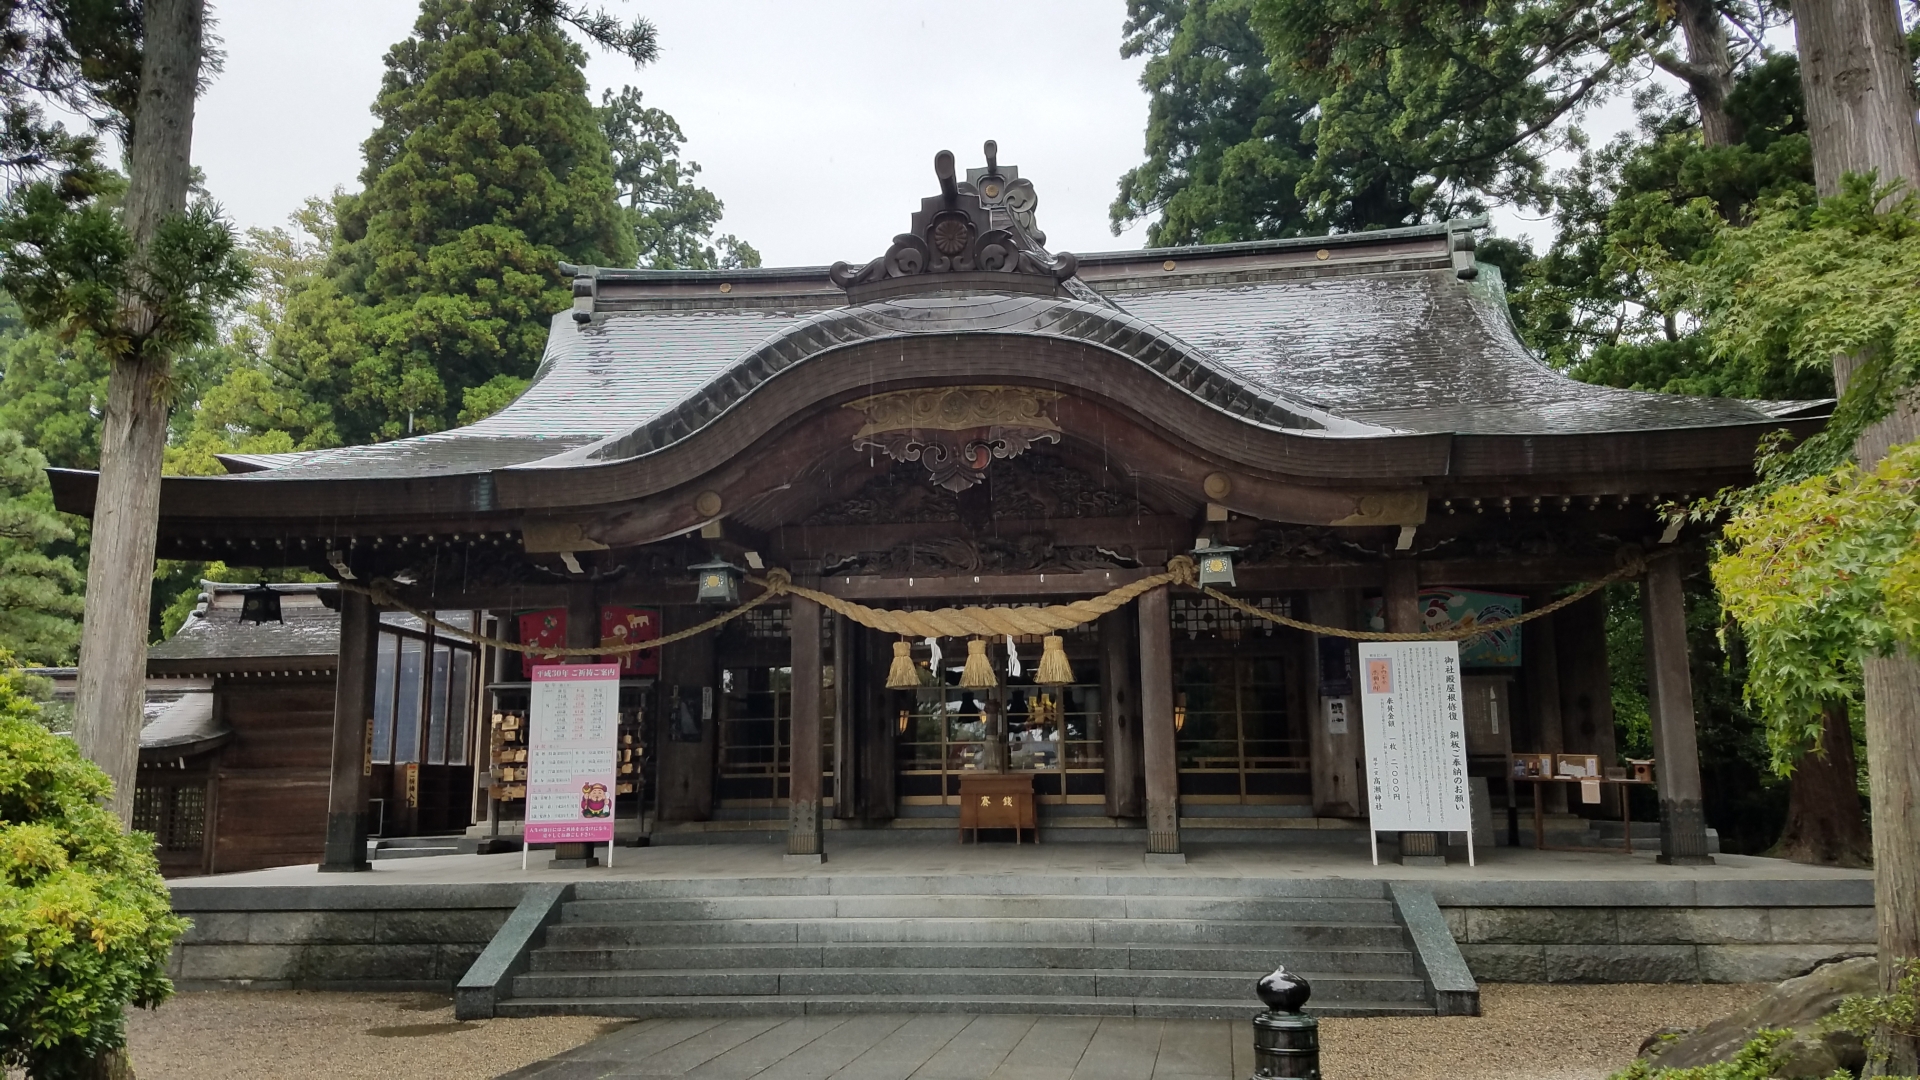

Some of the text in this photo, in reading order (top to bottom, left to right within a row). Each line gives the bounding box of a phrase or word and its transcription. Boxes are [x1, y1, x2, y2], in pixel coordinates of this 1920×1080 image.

[537, 669, 569, 678] 平成30年
[1389, 737, 1398, 751] 一枚
[1444, 656, 1465, 811] 御社殿屋根修復 銅板ご奉納のお願い
[1373, 777, 1384, 811] 高瀬神社
